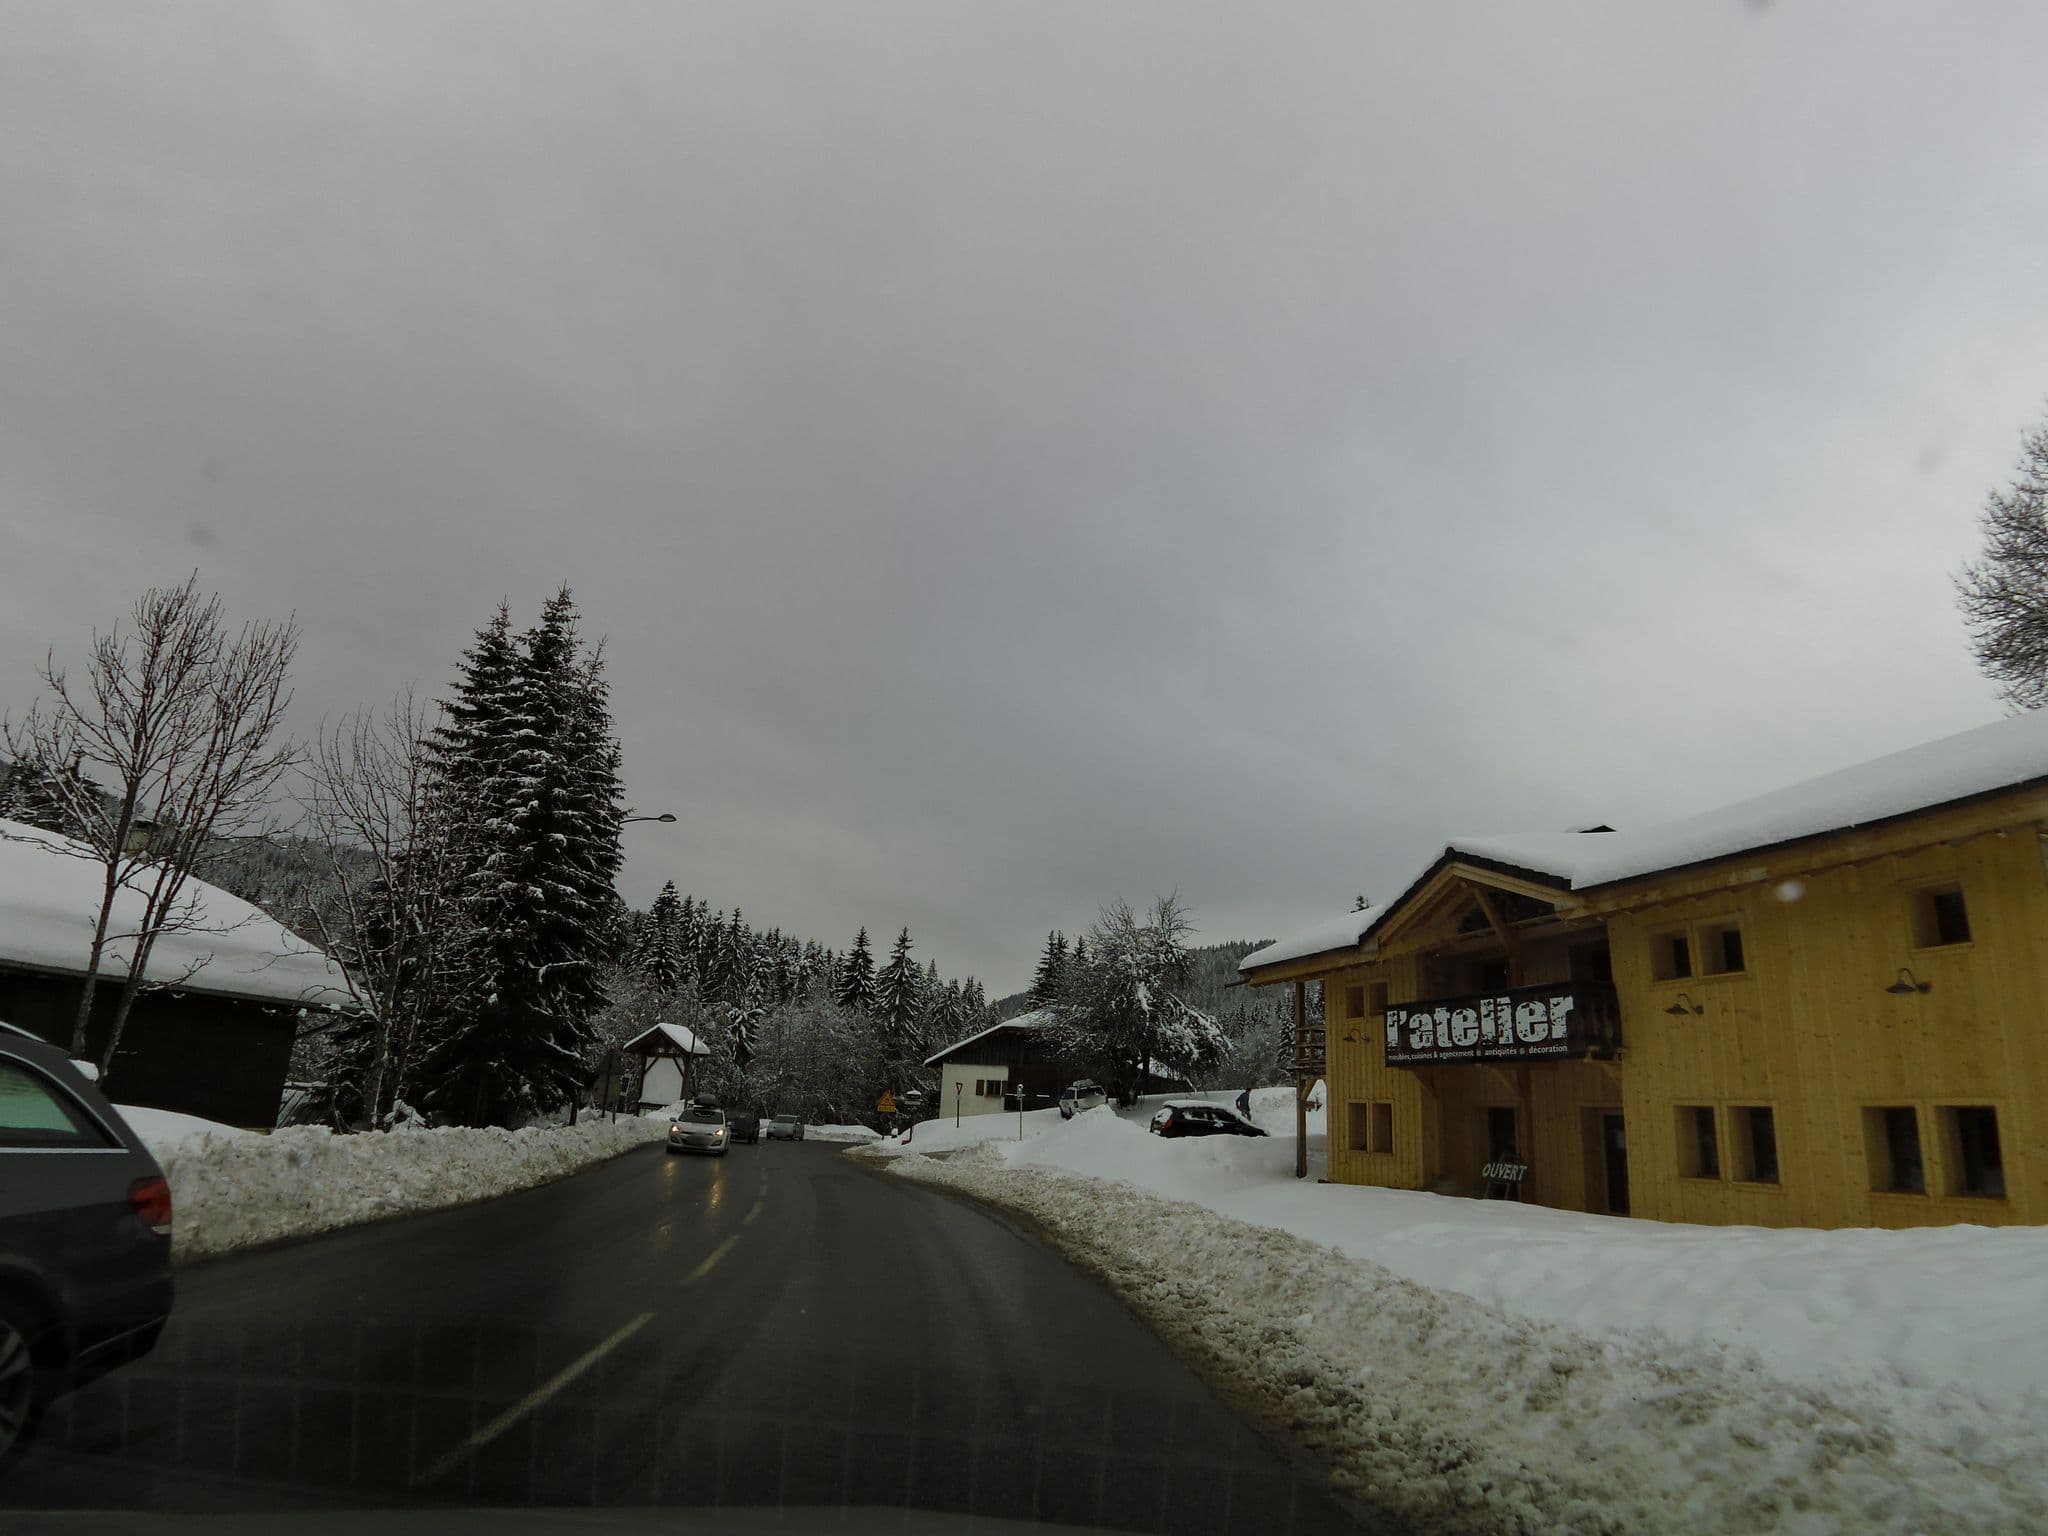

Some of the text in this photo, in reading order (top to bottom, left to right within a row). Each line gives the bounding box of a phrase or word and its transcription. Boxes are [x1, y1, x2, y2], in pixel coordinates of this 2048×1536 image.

[1485, 1047, 1517, 1056] antiquités
[1528, 1044, 1568, 1054] décoration
[1482, 1163, 1528, 1181] OUVERT
